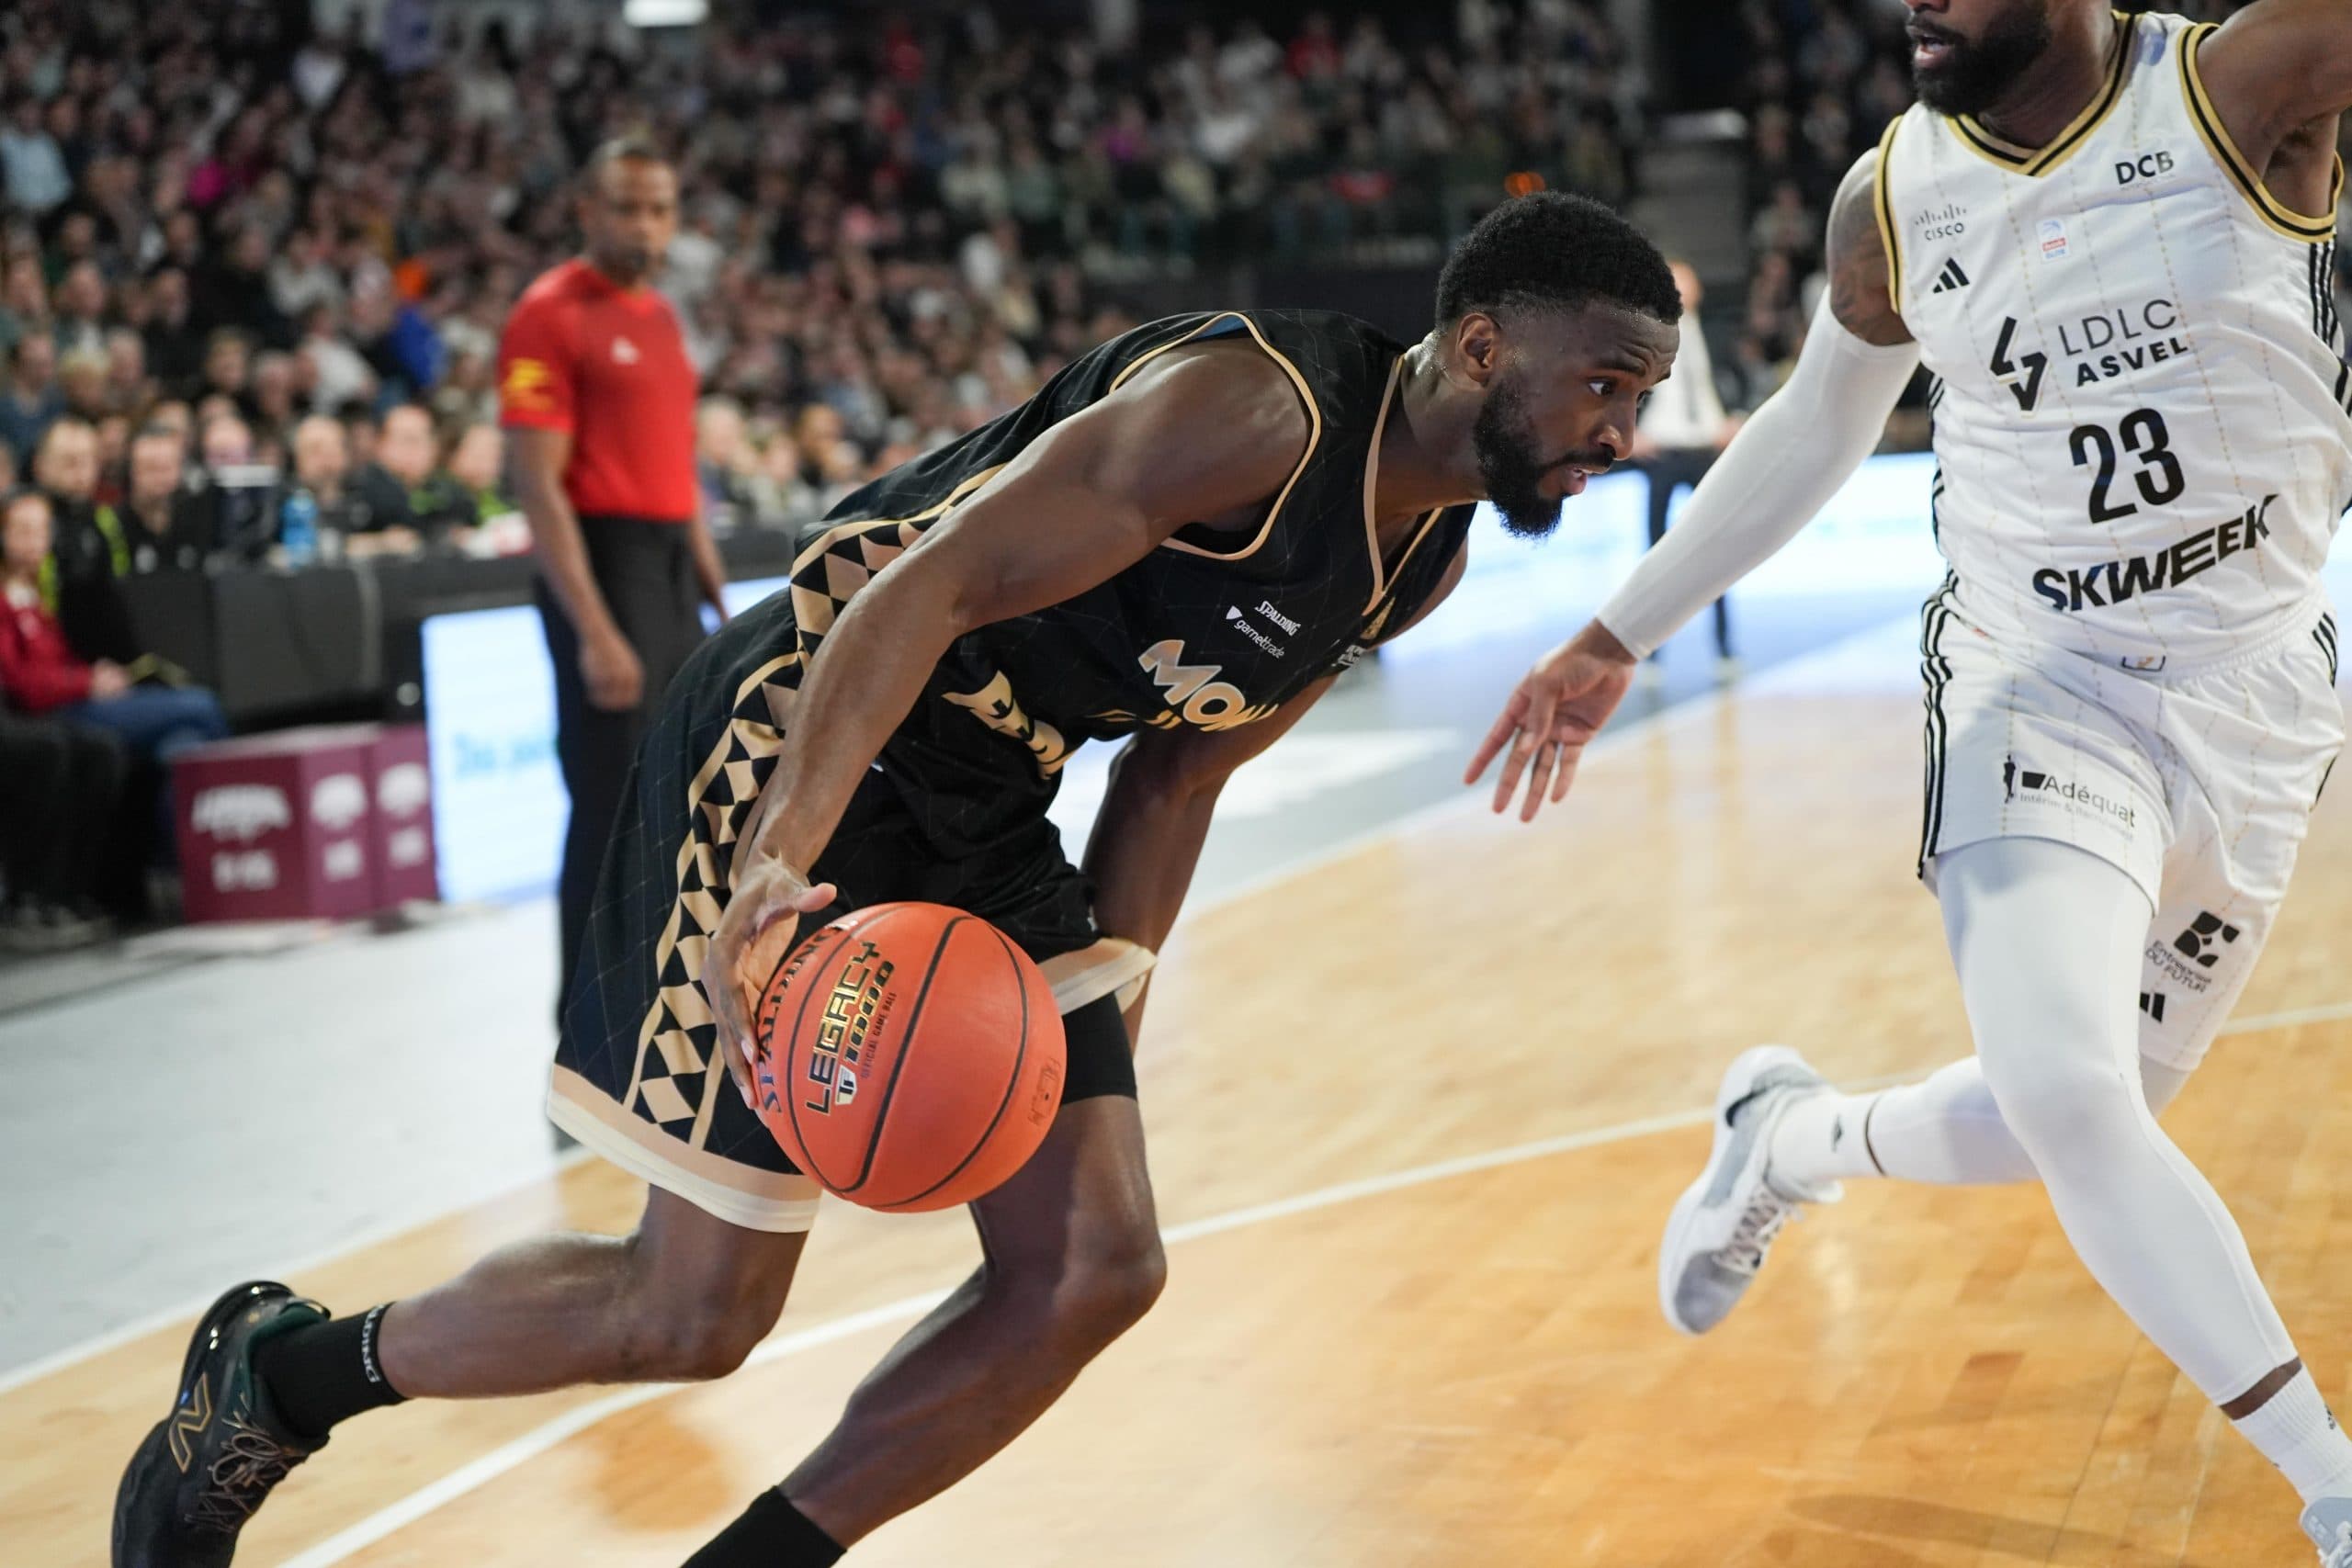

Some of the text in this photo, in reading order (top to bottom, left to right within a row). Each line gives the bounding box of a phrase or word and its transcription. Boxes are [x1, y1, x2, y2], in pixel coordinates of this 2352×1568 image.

[2115, 151, 2175, 185] DCB
[1924, 222, 1965, 241] CISCO
[2058, 299, 2177, 356] LDLC
[2075, 336, 2188, 388] ASVEL
[2068, 407, 2185, 524] 23
[2032, 493, 2278, 612] SKWEEK
[1254, 600, 1301, 636] SPALDING
[2043, 775, 2135, 828] Adéquat
[806, 941, 881, 1115] LEGACY
[842, 960, 895, 1066] 1000
